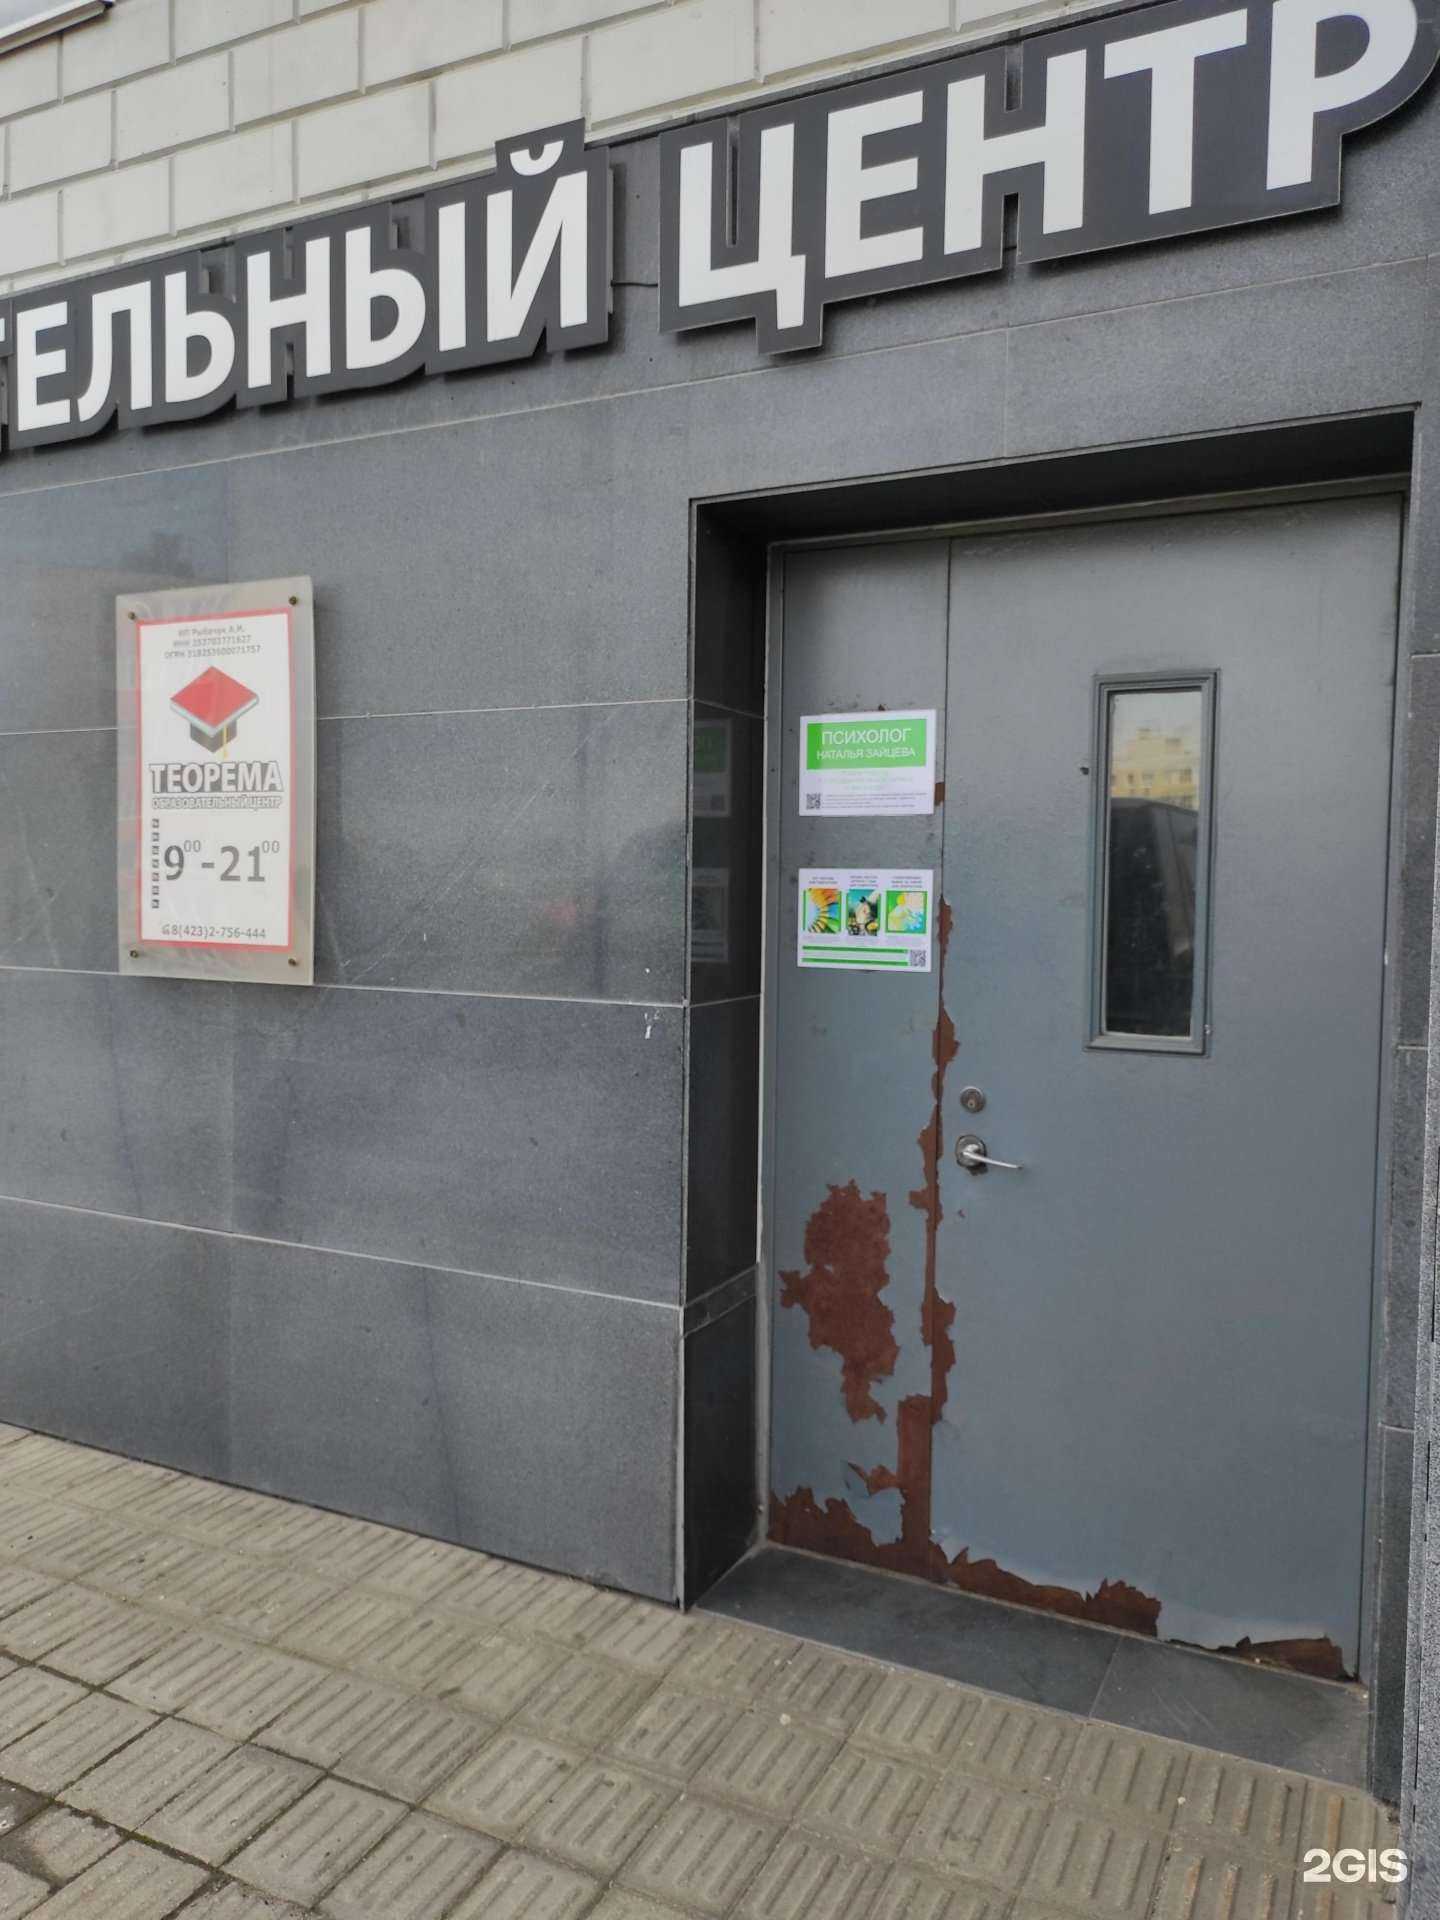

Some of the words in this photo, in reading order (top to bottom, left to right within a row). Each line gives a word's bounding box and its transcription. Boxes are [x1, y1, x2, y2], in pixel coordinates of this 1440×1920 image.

[0, 140, 588, 432] ЕЛЬНЫЙ
[678, 0, 1418, 330] ЦЕНТР
[821, 728, 912, 745] ПСИХОЛОГ
[149, 761, 284, 793] ТЕОРЕМА
